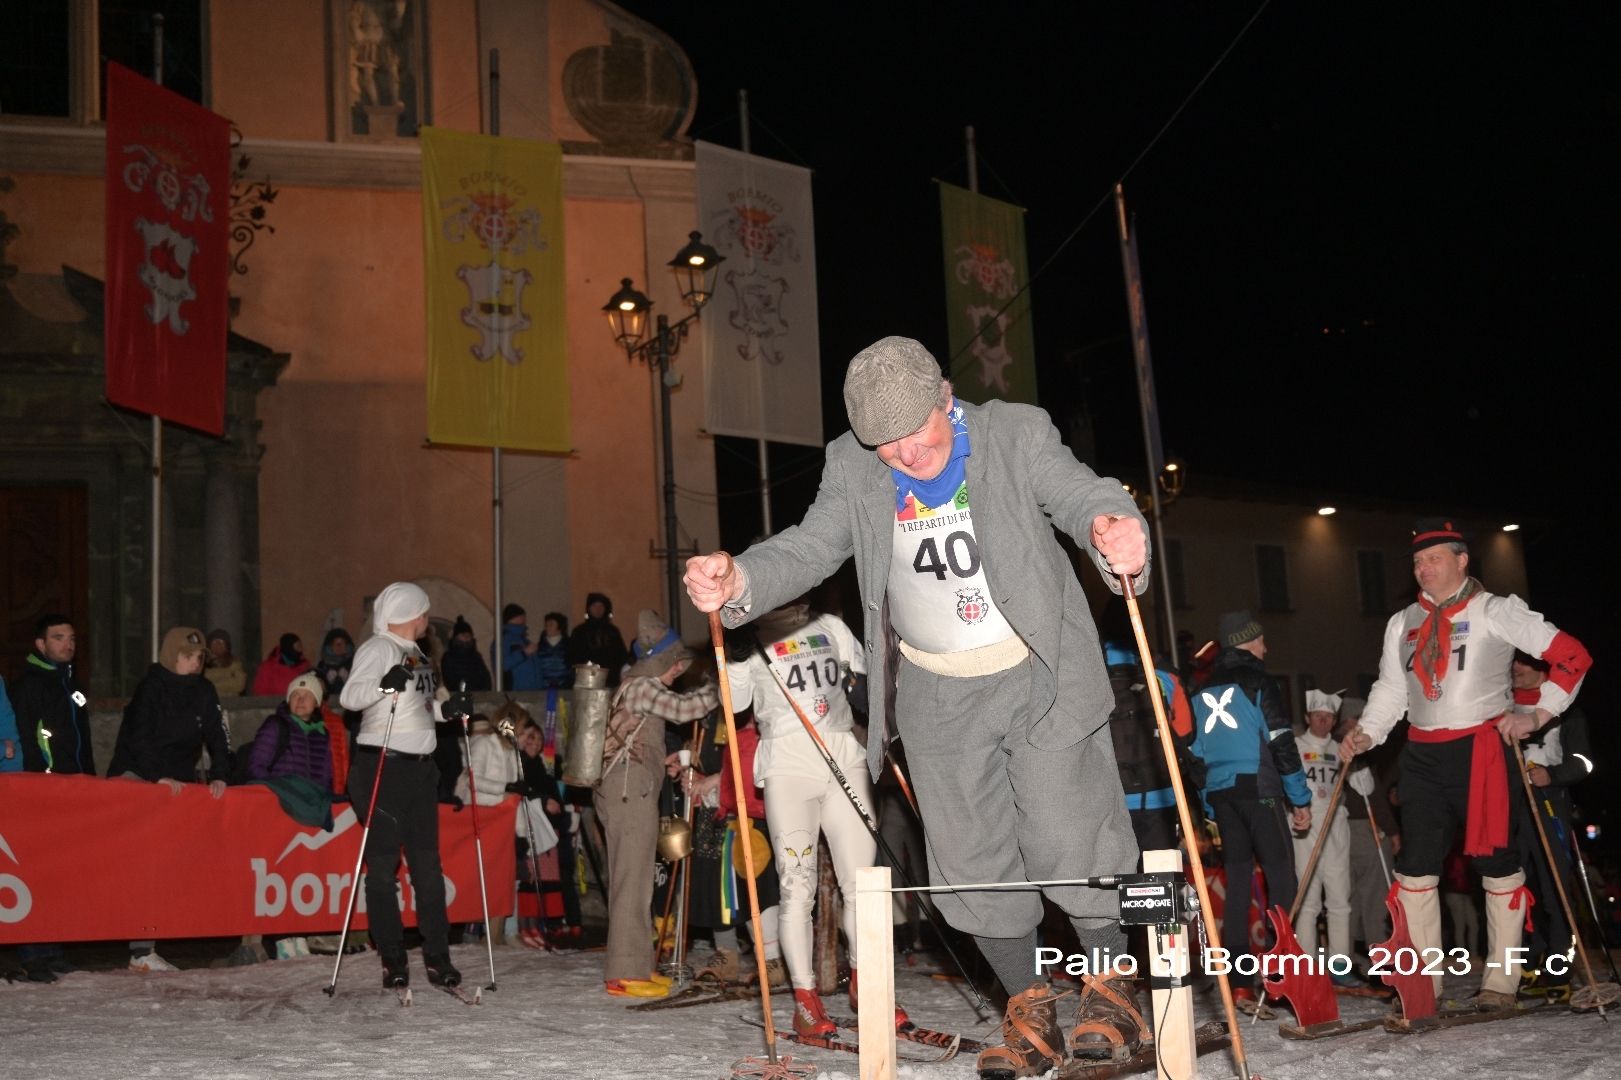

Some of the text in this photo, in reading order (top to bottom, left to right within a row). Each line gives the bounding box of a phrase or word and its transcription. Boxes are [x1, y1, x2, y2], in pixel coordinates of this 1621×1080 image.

[907, 516, 946, 532] REPARTI
[947, 513, 958, 525] DI
[786, 657, 839, 692] 410
[1306, 767, 1338, 784] 417
